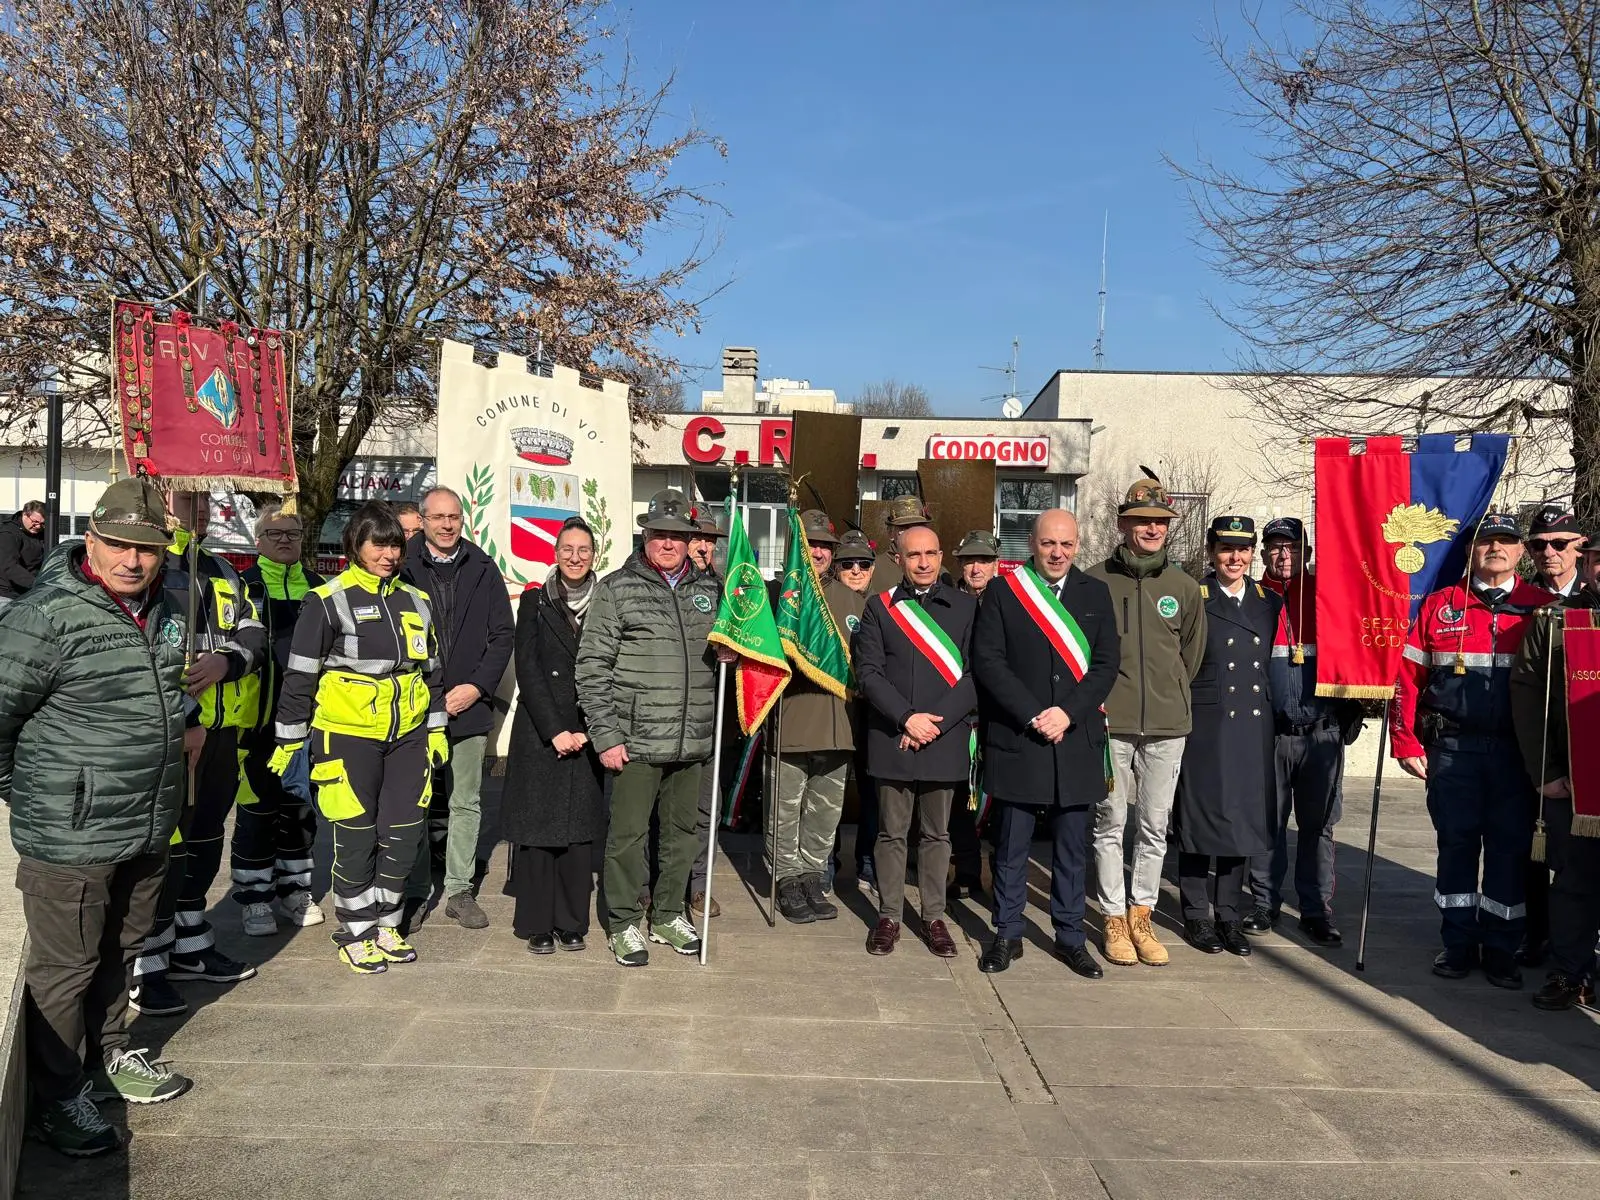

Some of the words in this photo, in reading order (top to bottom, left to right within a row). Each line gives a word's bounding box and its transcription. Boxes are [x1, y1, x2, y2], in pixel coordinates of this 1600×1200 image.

[159, 339, 248, 370] AVS
[475, 395, 541, 428] COMUNE
[551, 401, 568, 419] DI
[932, 440, 1047, 462] CODOGNO
[92, 632, 139, 644] GIVOVA
[1361, 634, 1409, 647] COD
